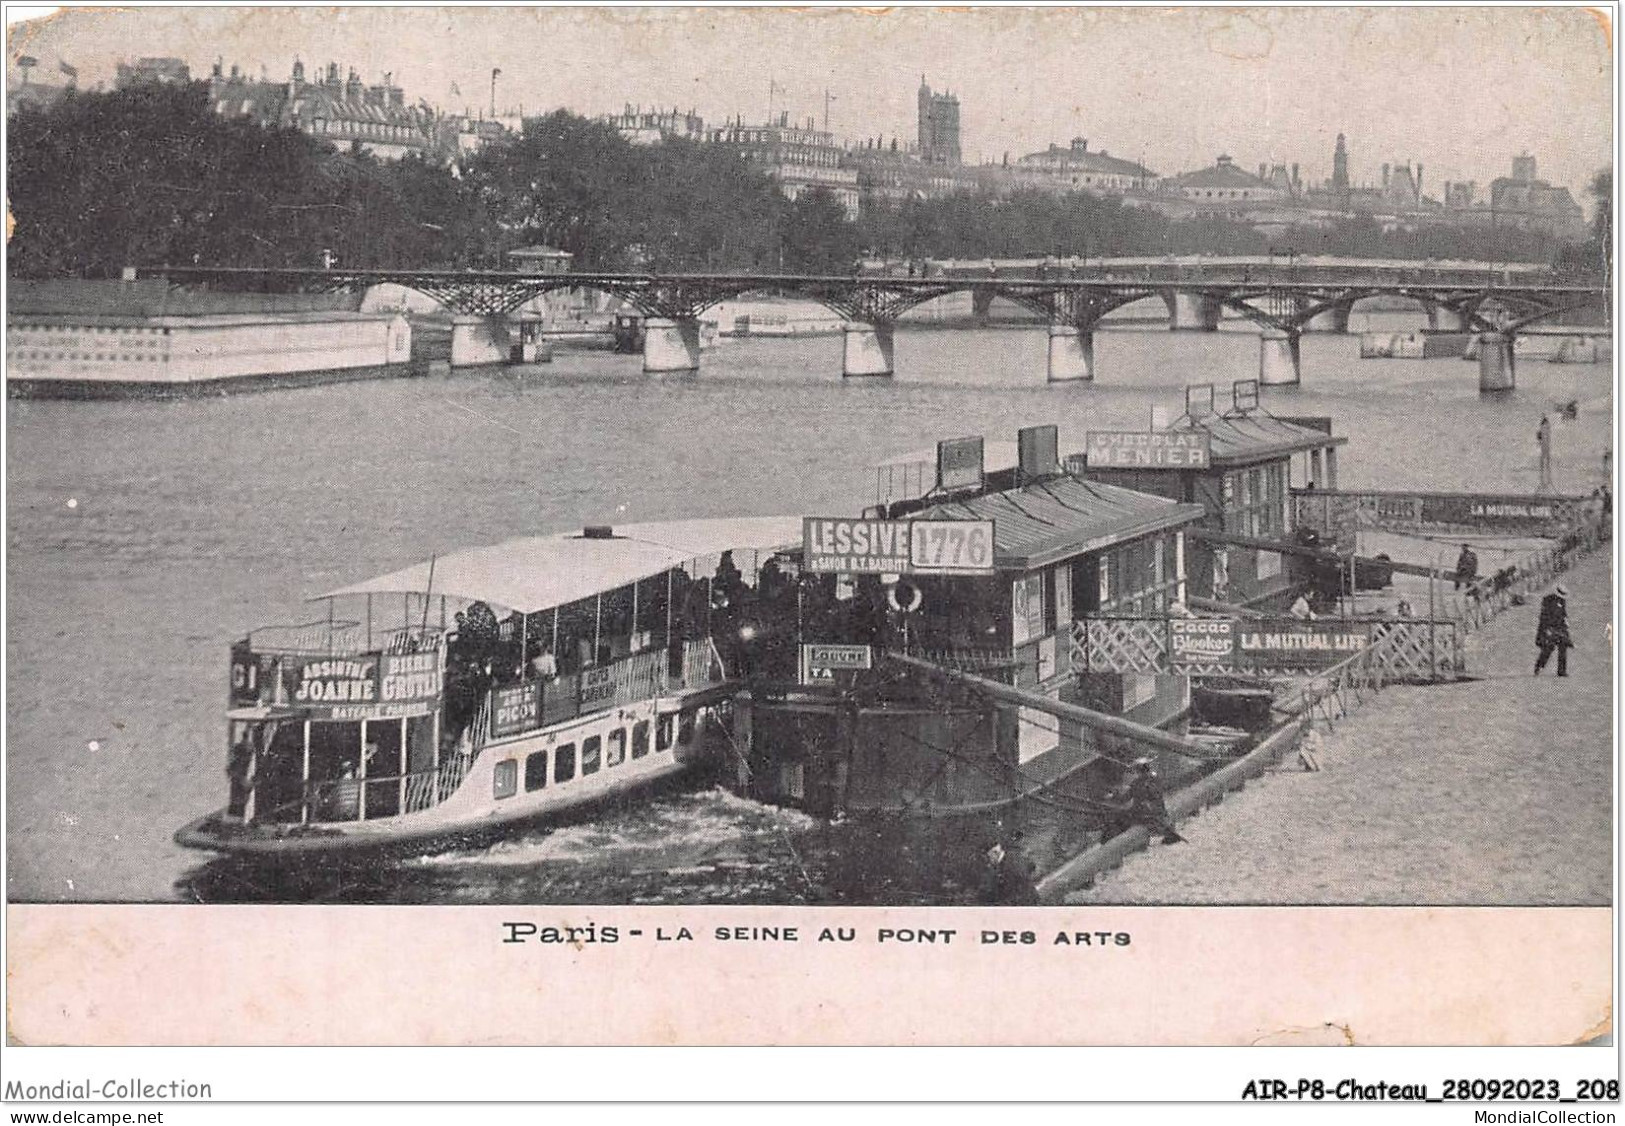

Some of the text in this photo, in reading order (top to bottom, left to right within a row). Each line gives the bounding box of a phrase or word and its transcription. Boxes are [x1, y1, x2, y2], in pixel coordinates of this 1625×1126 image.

[1097, 434, 1200, 447] CHOCOLAT
[1087, 449, 1204, 465] MENIER
[810, 521, 987, 566] LESSIVE 1776
[1172, 621, 1231, 634] Cacao
[1172, 634, 1233, 654] Blooker
[1240, 633, 1367, 650] LA MUTUAL LIFE
[303, 660, 377, 680] ABSINTHE
[296, 679, 374, 701] JOANNE
